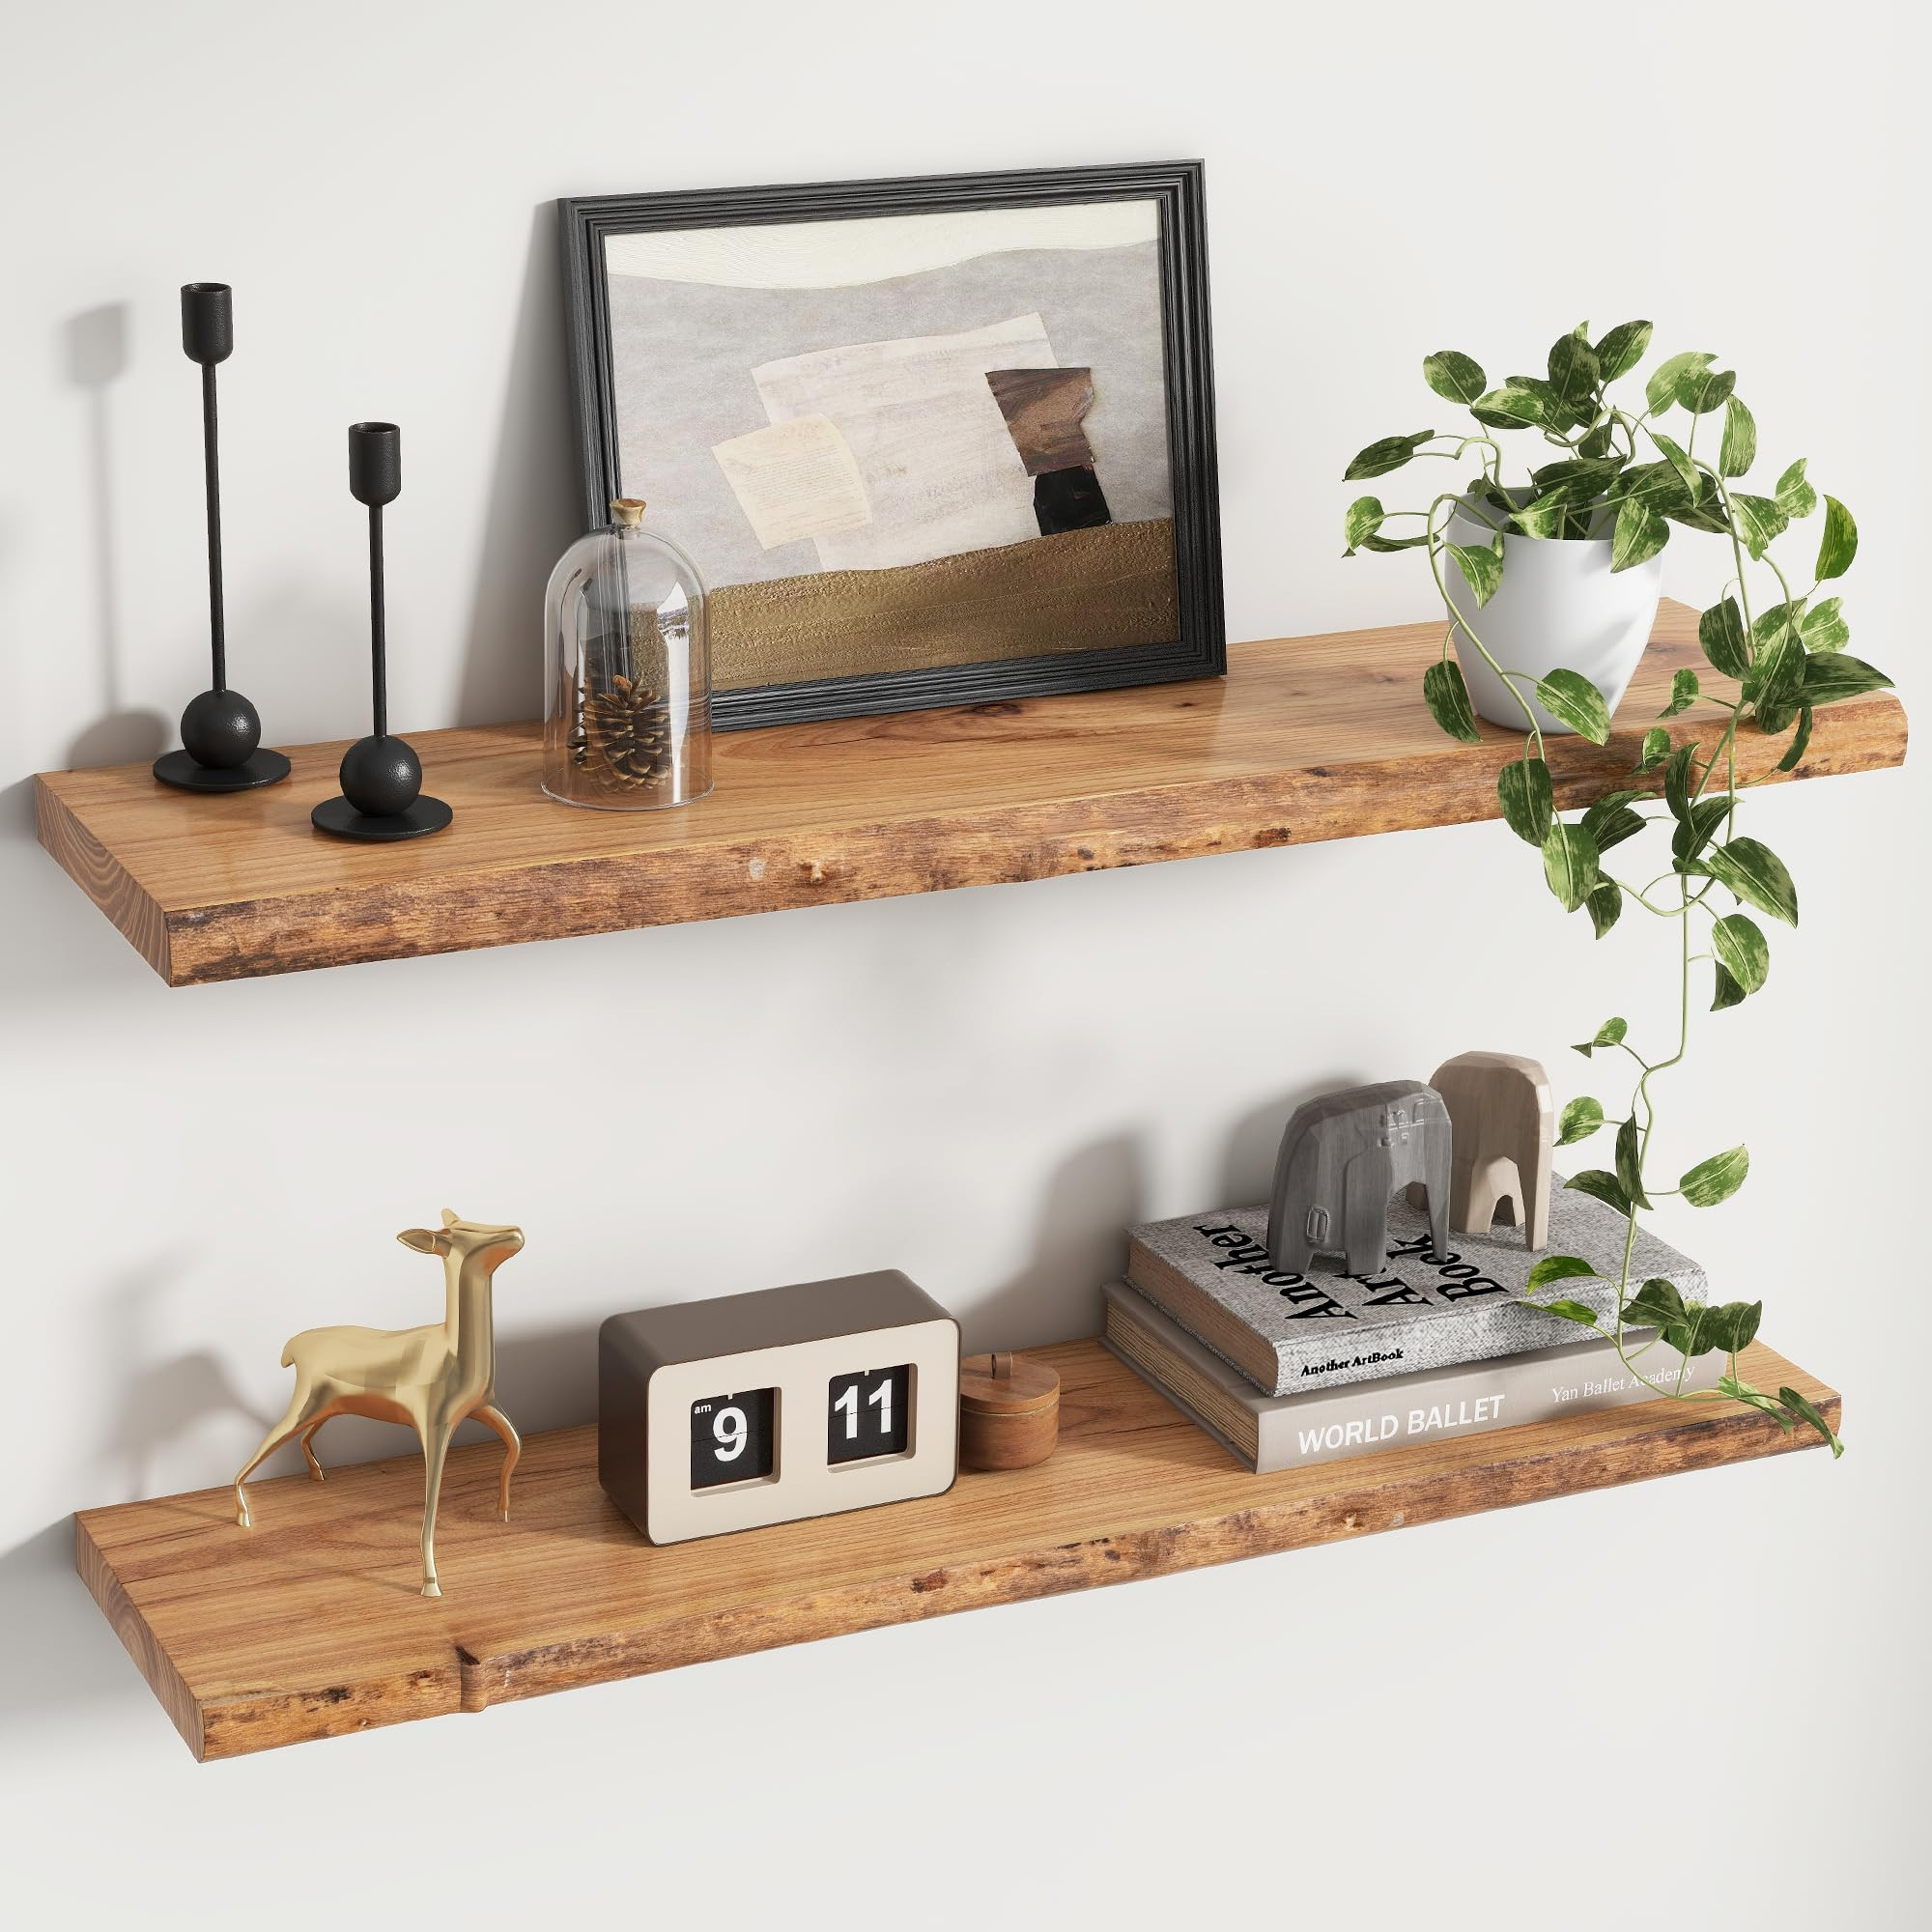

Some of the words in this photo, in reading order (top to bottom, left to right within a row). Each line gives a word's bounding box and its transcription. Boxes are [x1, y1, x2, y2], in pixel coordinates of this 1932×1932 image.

[1192, 1224, 1359, 1320] Another
[1385, 1233, 1510, 1303] Book
[1300, 1359, 1350, 1377] Another
[1351, 1349, 1404, 1367] ArtBook
[1551, 1386, 1578, 1403] Yan
[1583, 1377, 1625, 1397] Ballet
[1628, 1365, 1696, 1389] Academy
[694, 1403, 712, 1414] am
[712, 1406, 748, 1463] 9
[834, 1378, 893, 1439] 11
[1297, 1414, 1400, 1455] WORLD
[1406, 1394, 1505, 1435] BALLET
